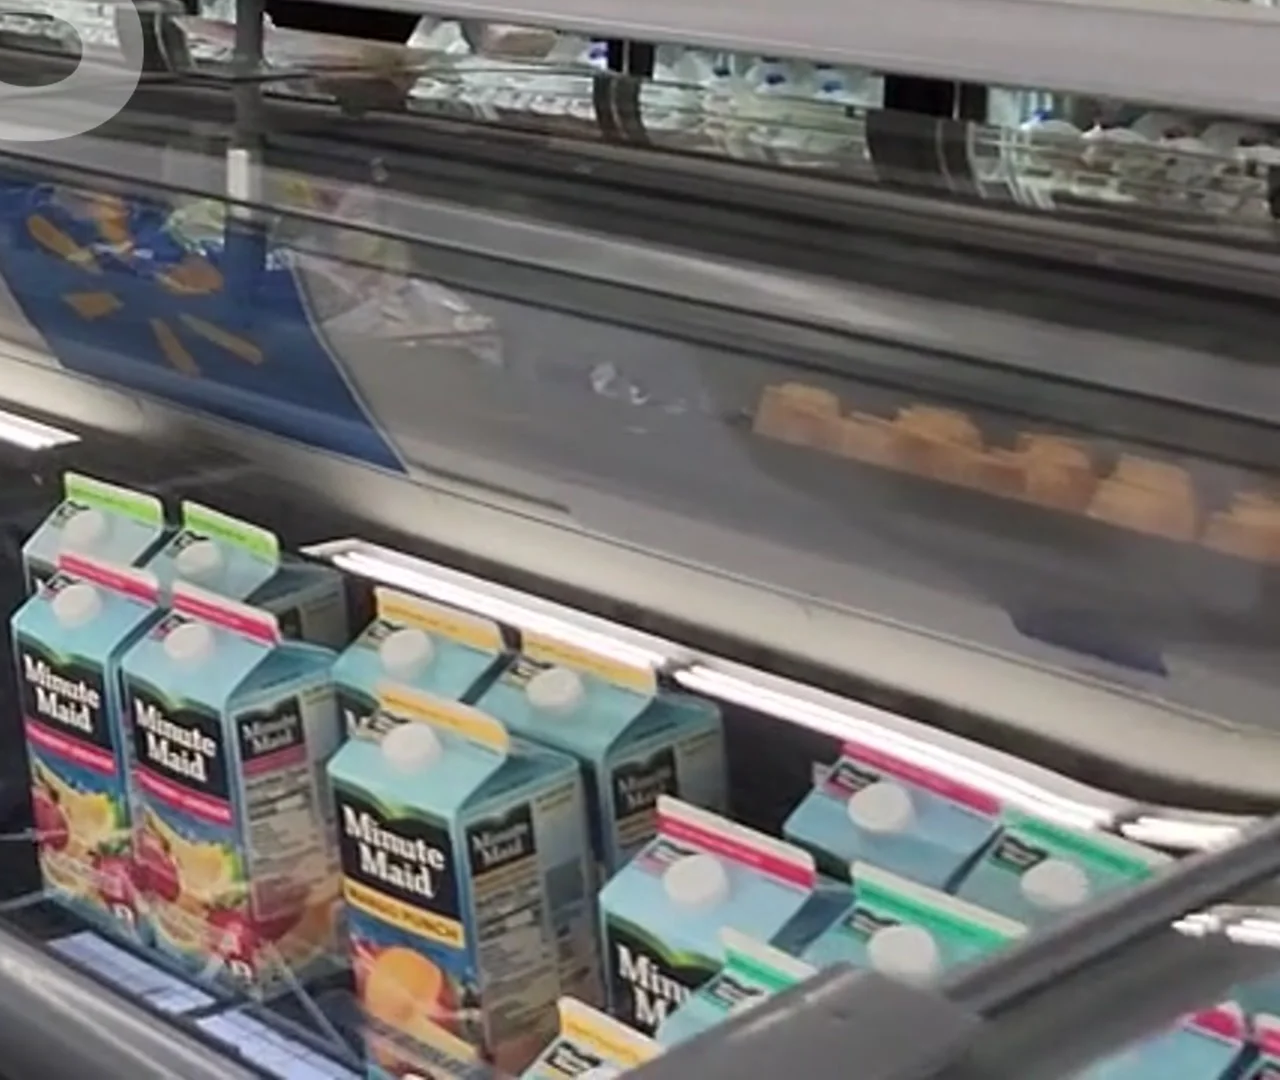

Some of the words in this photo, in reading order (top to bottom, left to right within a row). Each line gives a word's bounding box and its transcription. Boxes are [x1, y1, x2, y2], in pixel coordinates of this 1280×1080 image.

[24, 653, 101, 709] Minute
[36, 687, 93, 734] Maid
[134, 697, 217, 758] Minute
[146, 733, 207, 783] Maid
[342, 804, 446, 872] Minute
[358, 841, 436, 900] Maid
[616, 942, 690, 1005] Min
